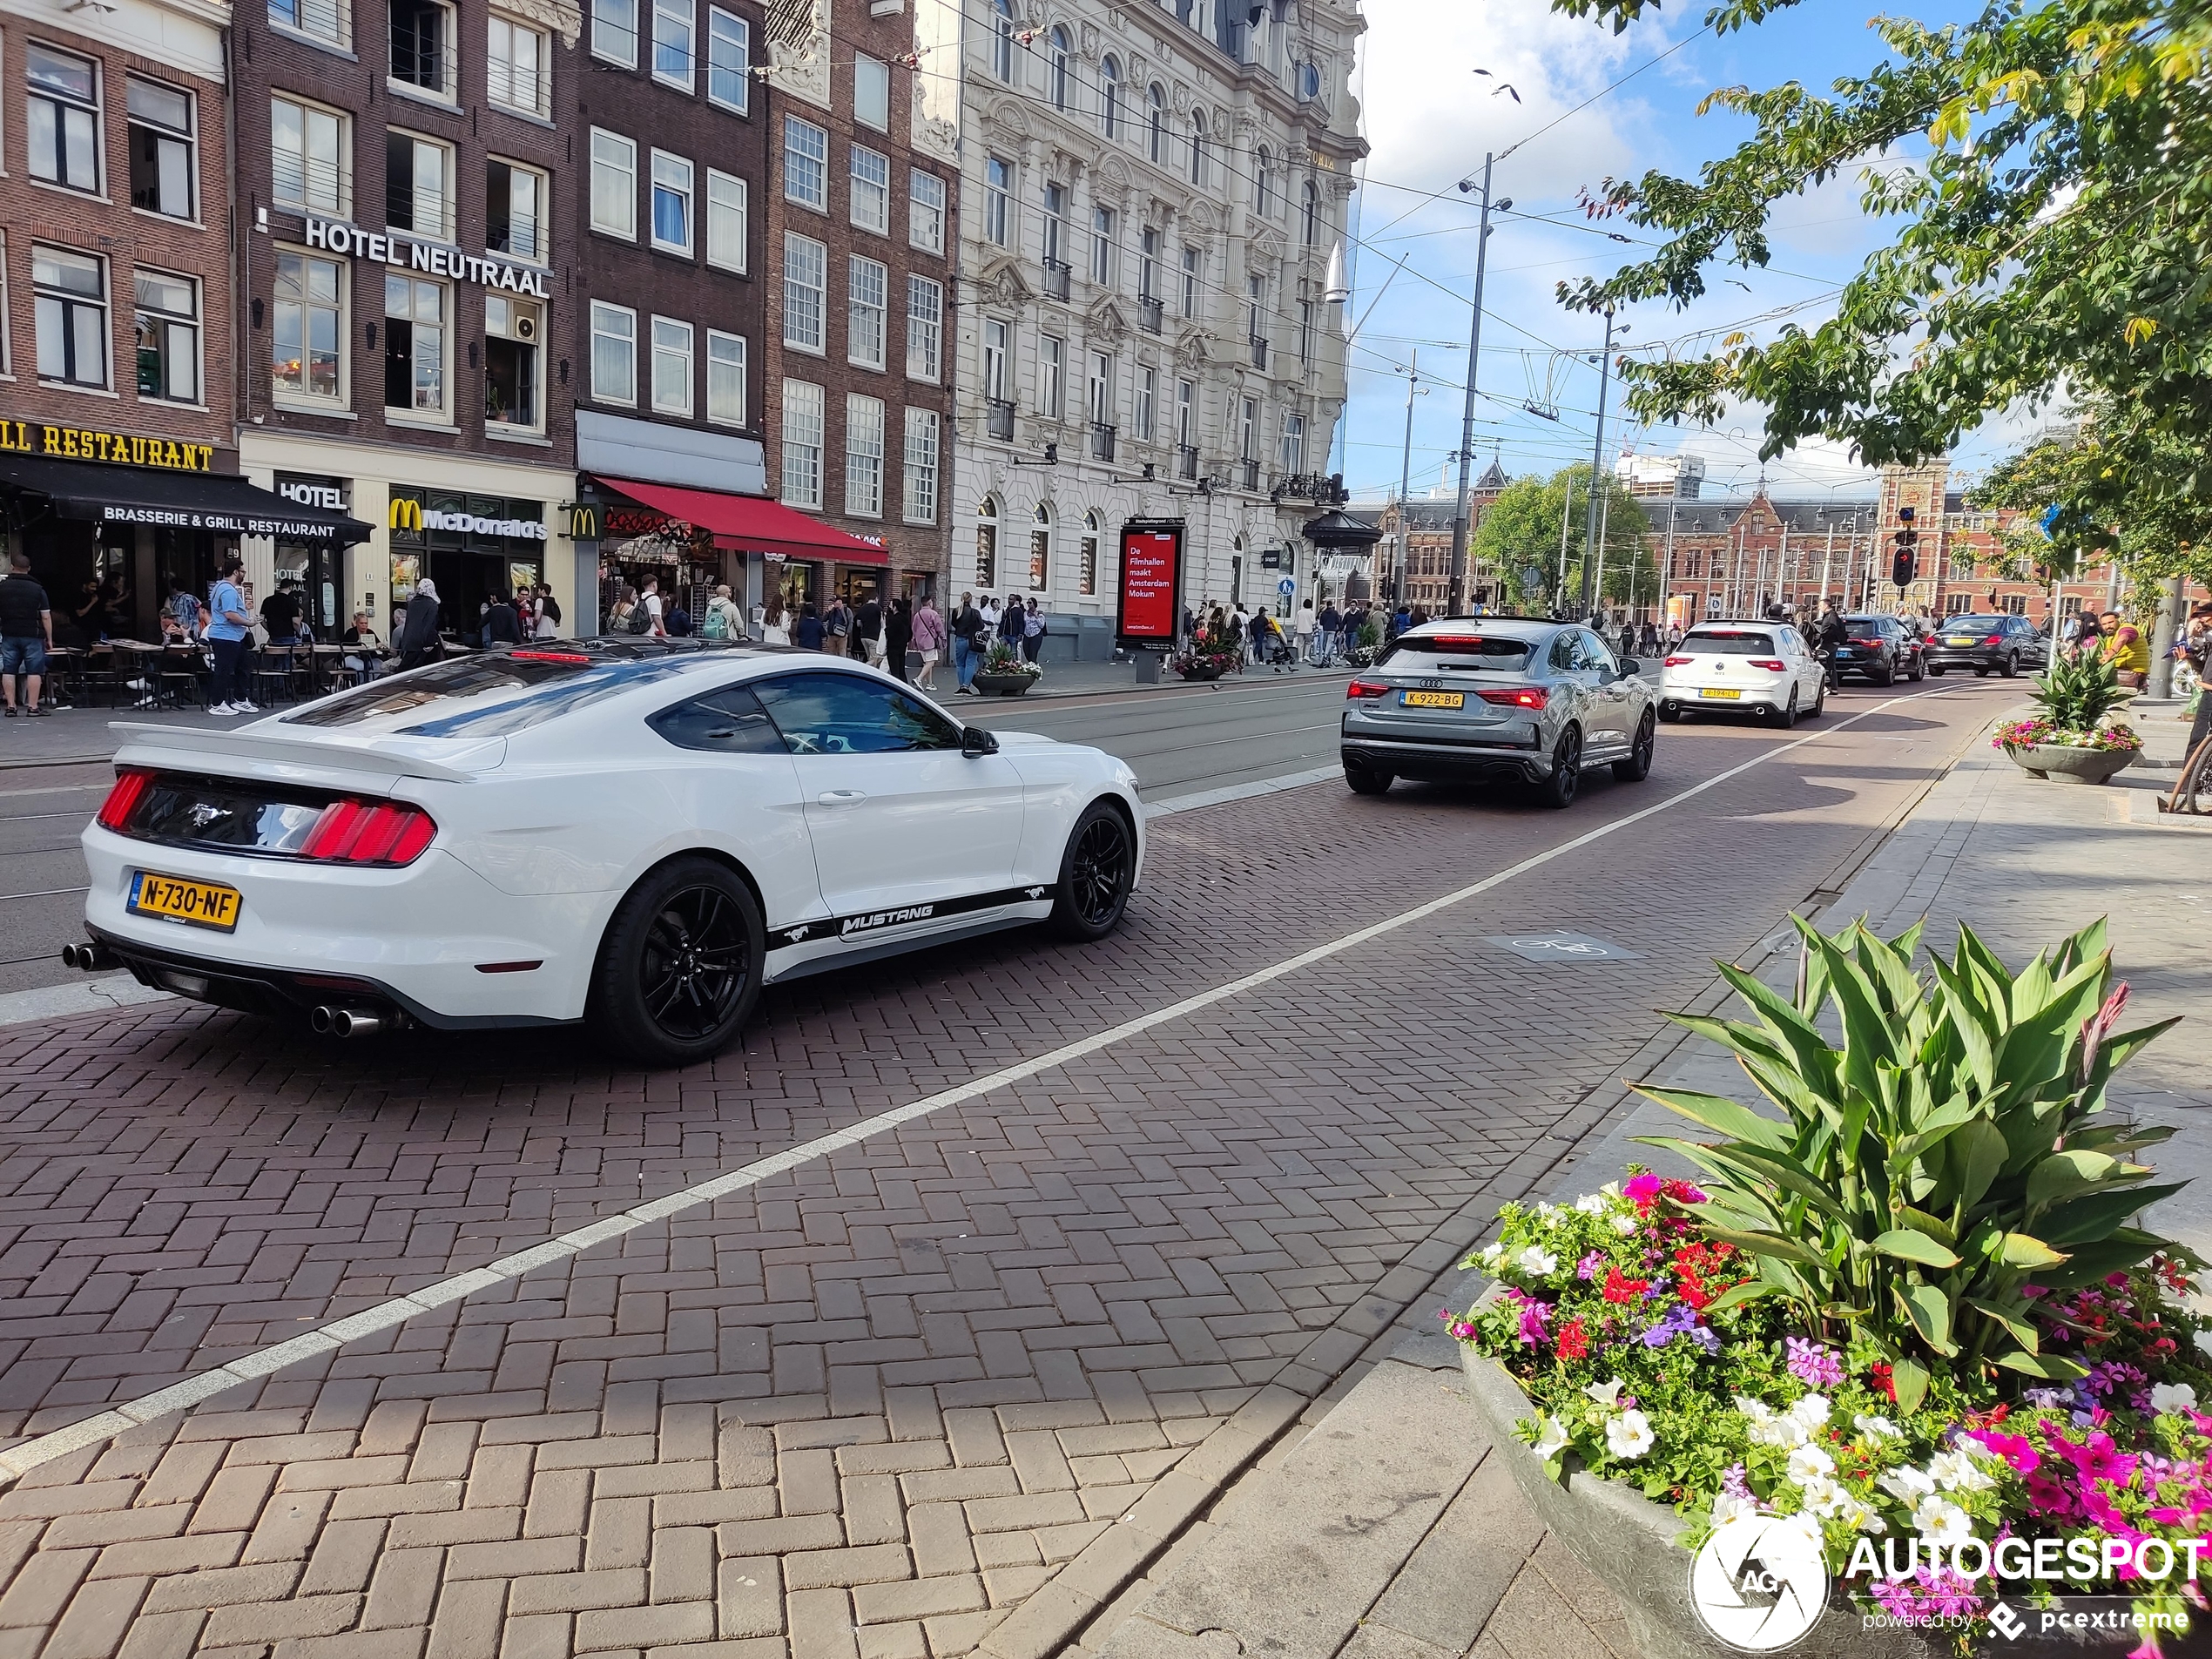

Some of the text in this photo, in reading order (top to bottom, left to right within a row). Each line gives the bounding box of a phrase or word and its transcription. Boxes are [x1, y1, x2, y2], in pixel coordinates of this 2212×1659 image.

[306, 218, 550, 299] HOTEL NEUTRAAL
[44, 426, 212, 471] RESTAURANT
[280, 482, 347, 509] HOTEL
[104, 507, 335, 537] BRASSERIE & GRILL RESTAURANT
[421, 509, 549, 540] McDonald's
[233, 549, 239, 558] 9
[1130, 557, 1165, 566] Filmhallen
[273, 568, 307, 581] HOTEL
[1129, 568, 1151, 577] maakt
[1129, 578, 1170, 587] Amsterdam
[1409, 693, 1459, 705] K-922-BG
[144, 880, 233, 919] N-730-NF
[841, 905, 934, 934] MUSTANG
